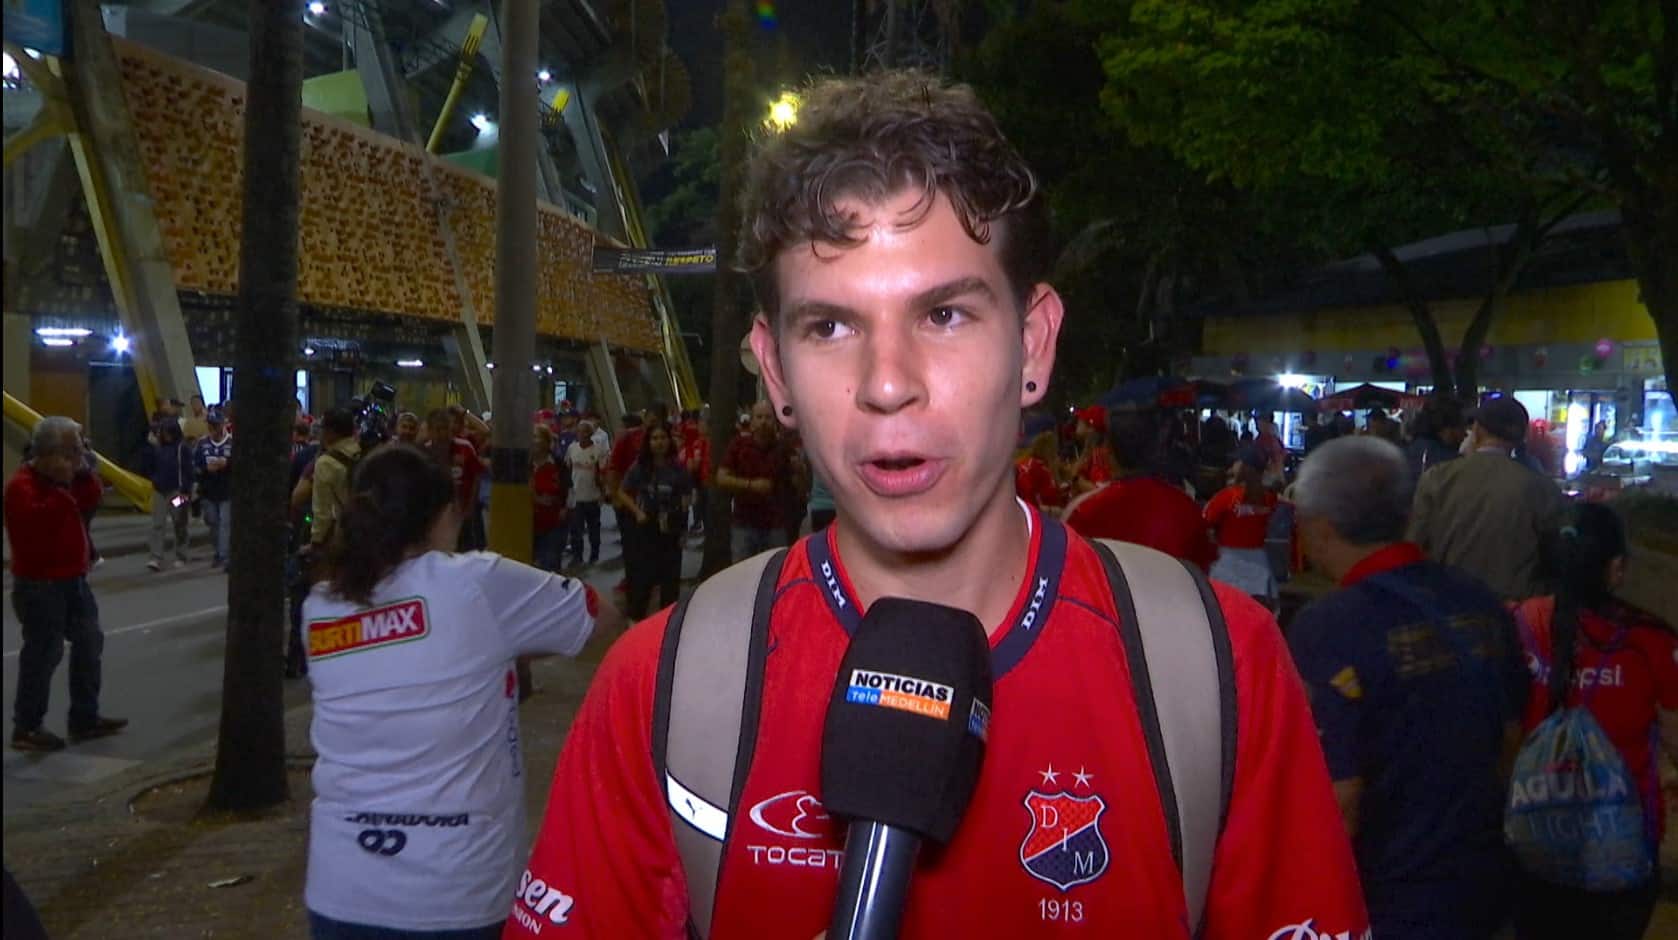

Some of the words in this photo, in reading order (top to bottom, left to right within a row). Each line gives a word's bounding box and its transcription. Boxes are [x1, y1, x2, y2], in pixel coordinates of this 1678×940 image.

[820, 559, 846, 608] DIM
[1020, 576, 1049, 631] DIM
[854, 672, 949, 702] NOTICIAS
[1038, 896, 1085, 923] 1913
